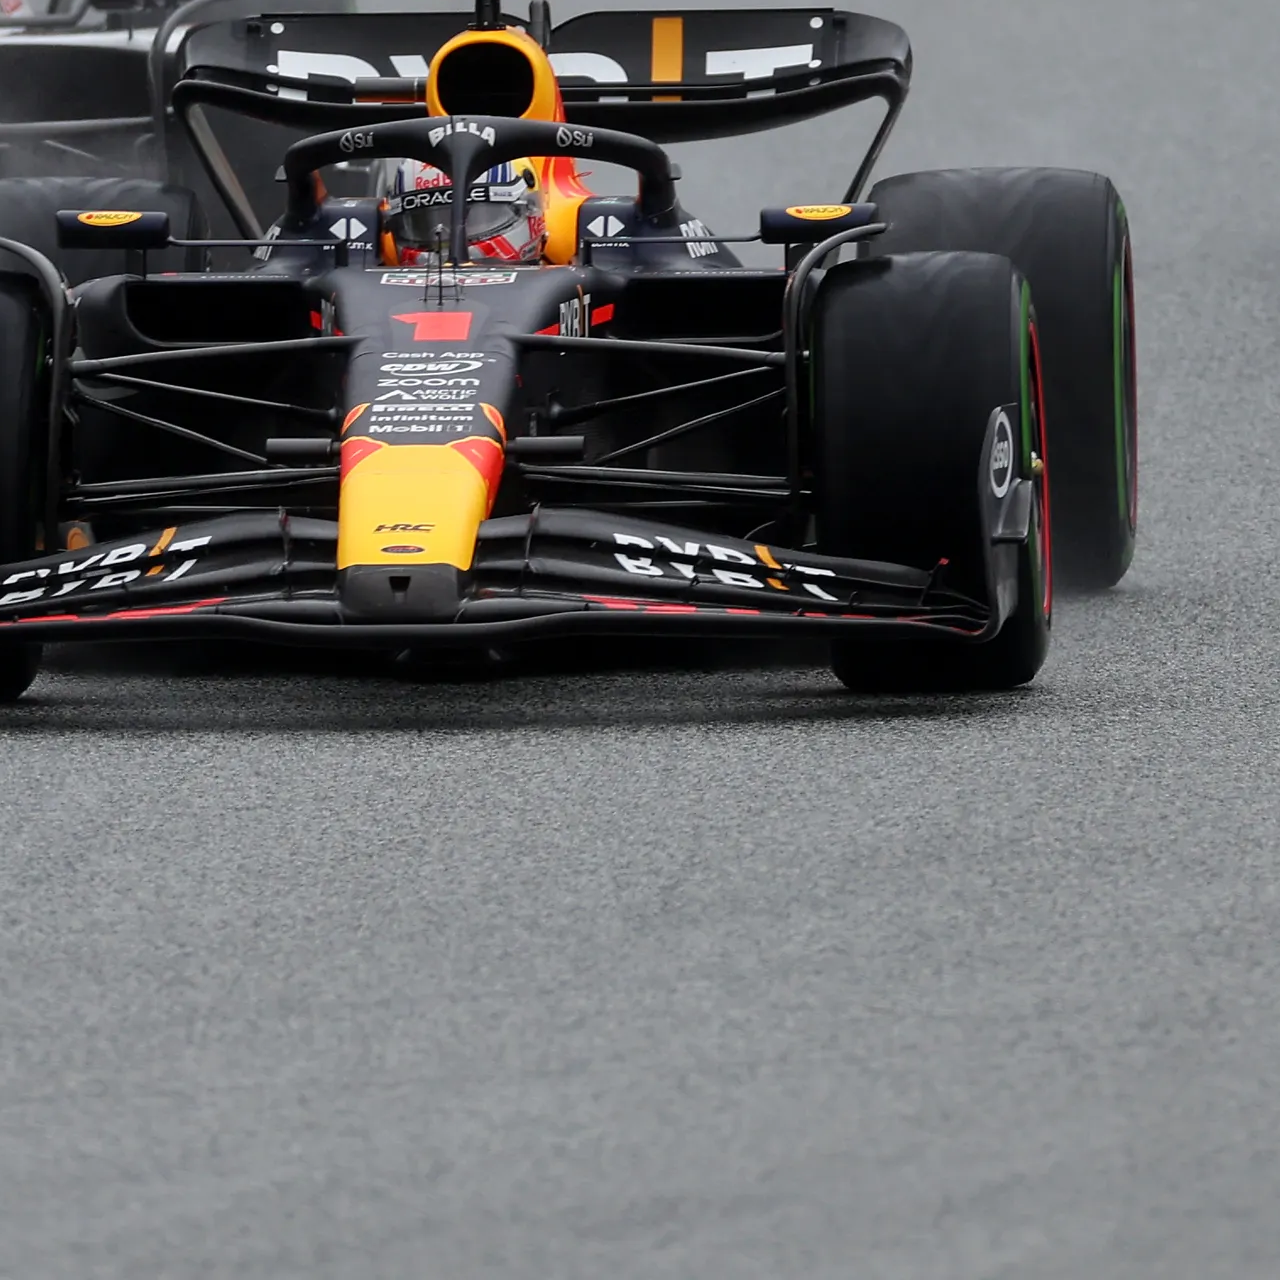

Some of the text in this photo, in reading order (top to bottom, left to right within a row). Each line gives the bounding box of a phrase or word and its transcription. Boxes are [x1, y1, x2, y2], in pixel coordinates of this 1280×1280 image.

[427, 122, 496, 148] BILLA
[572, 131, 594, 148] Sui
[403, 186, 486, 210] ORACE
[391, 311, 473, 342] 1
[439, 351, 485, 359] App
[380, 363, 461, 372] CDW
[376, 378, 480, 387] zoom
[371, 403, 476, 412] PIRELLI
[369, 414, 474, 422] infinitum
[368, 424, 443, 433] Mobil
